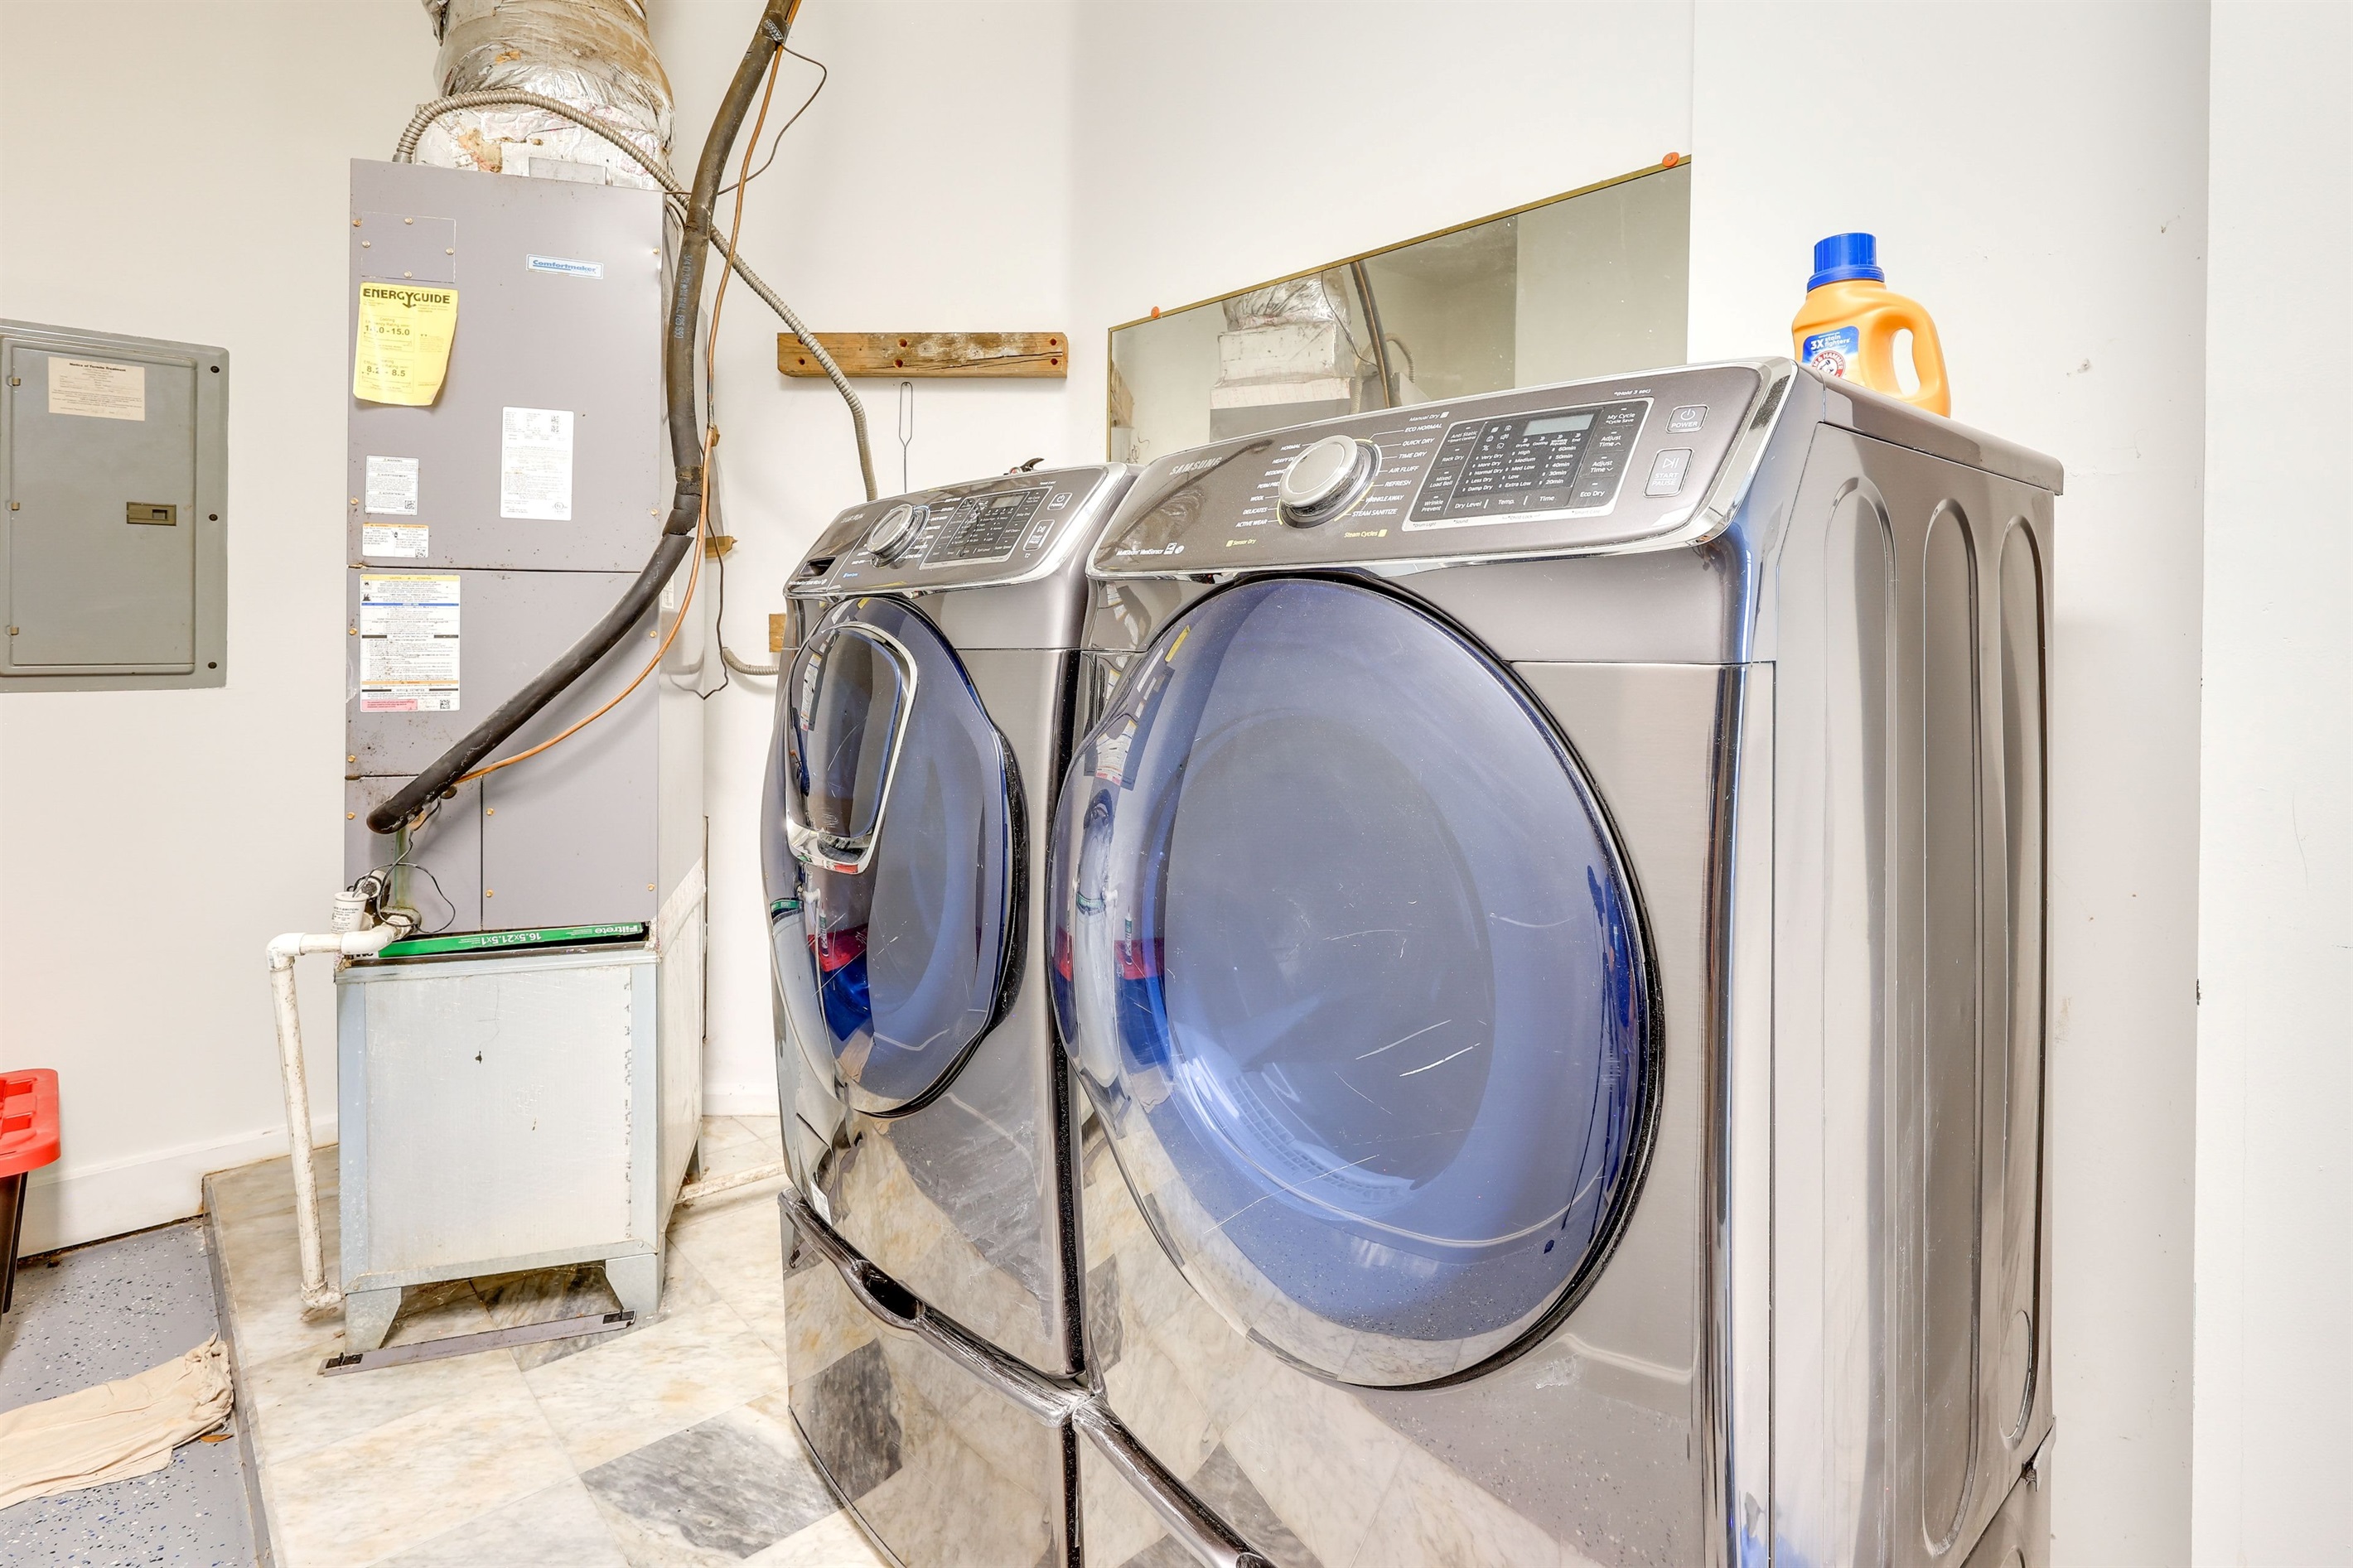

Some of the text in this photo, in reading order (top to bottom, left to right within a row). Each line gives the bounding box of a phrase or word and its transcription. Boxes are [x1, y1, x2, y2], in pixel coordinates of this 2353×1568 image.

[533, 259, 597, 272] Comfortmaker
[363, 288, 451, 306] ENERGYGUIDE
[365, 325, 384, 334] 1.0
[1810, 333, 1841, 350] 3X stain
[1824, 338, 1850, 347] fighters
[1169, 456, 1222, 475] SAMSUNG
[1360, 530, 1378, 538] Cycles
[595, 924, 639, 934] Filtrete
[481, 932, 542, 946] 16.5x21.5x1
